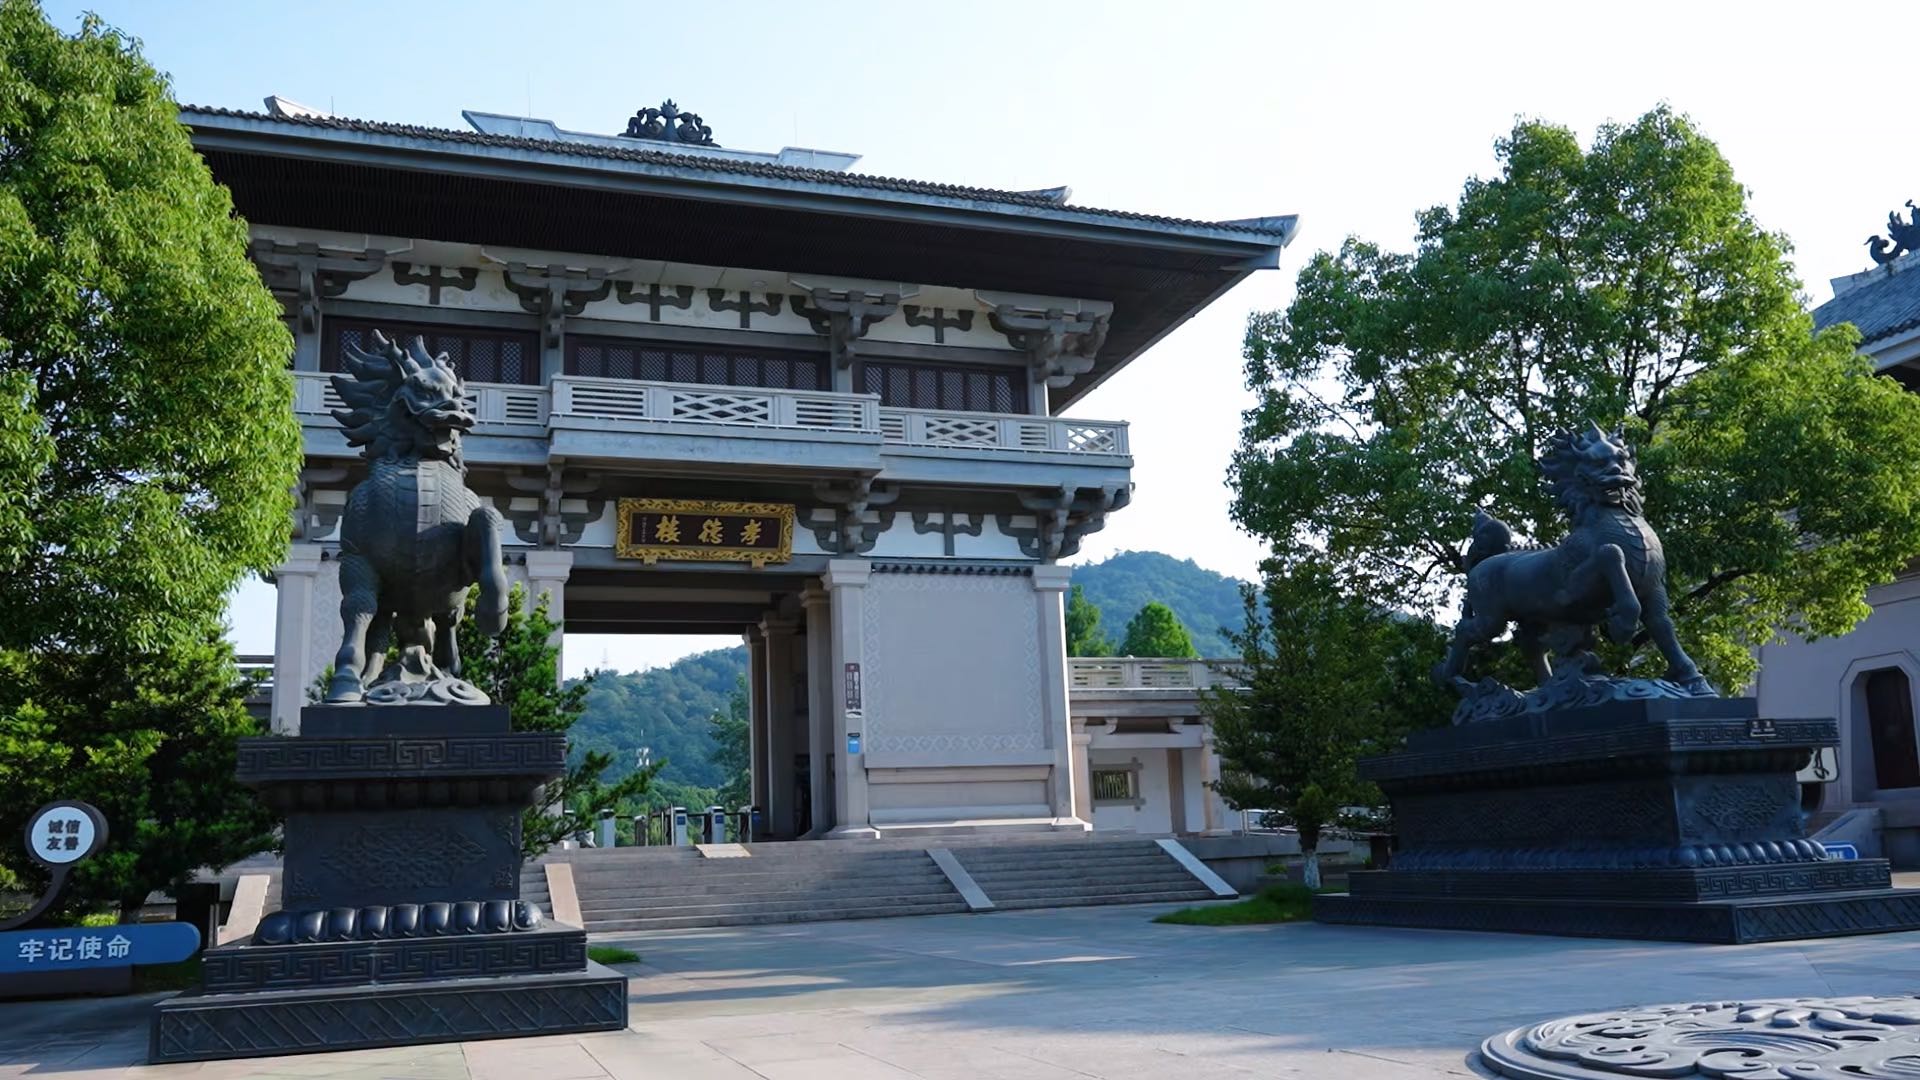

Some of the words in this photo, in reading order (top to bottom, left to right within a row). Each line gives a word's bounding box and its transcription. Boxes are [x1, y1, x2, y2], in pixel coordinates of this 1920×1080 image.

[48, 819, 81, 834] 诚信
[46, 836, 79, 850] 友善
[18, 934, 132, 963] 牢记使命
